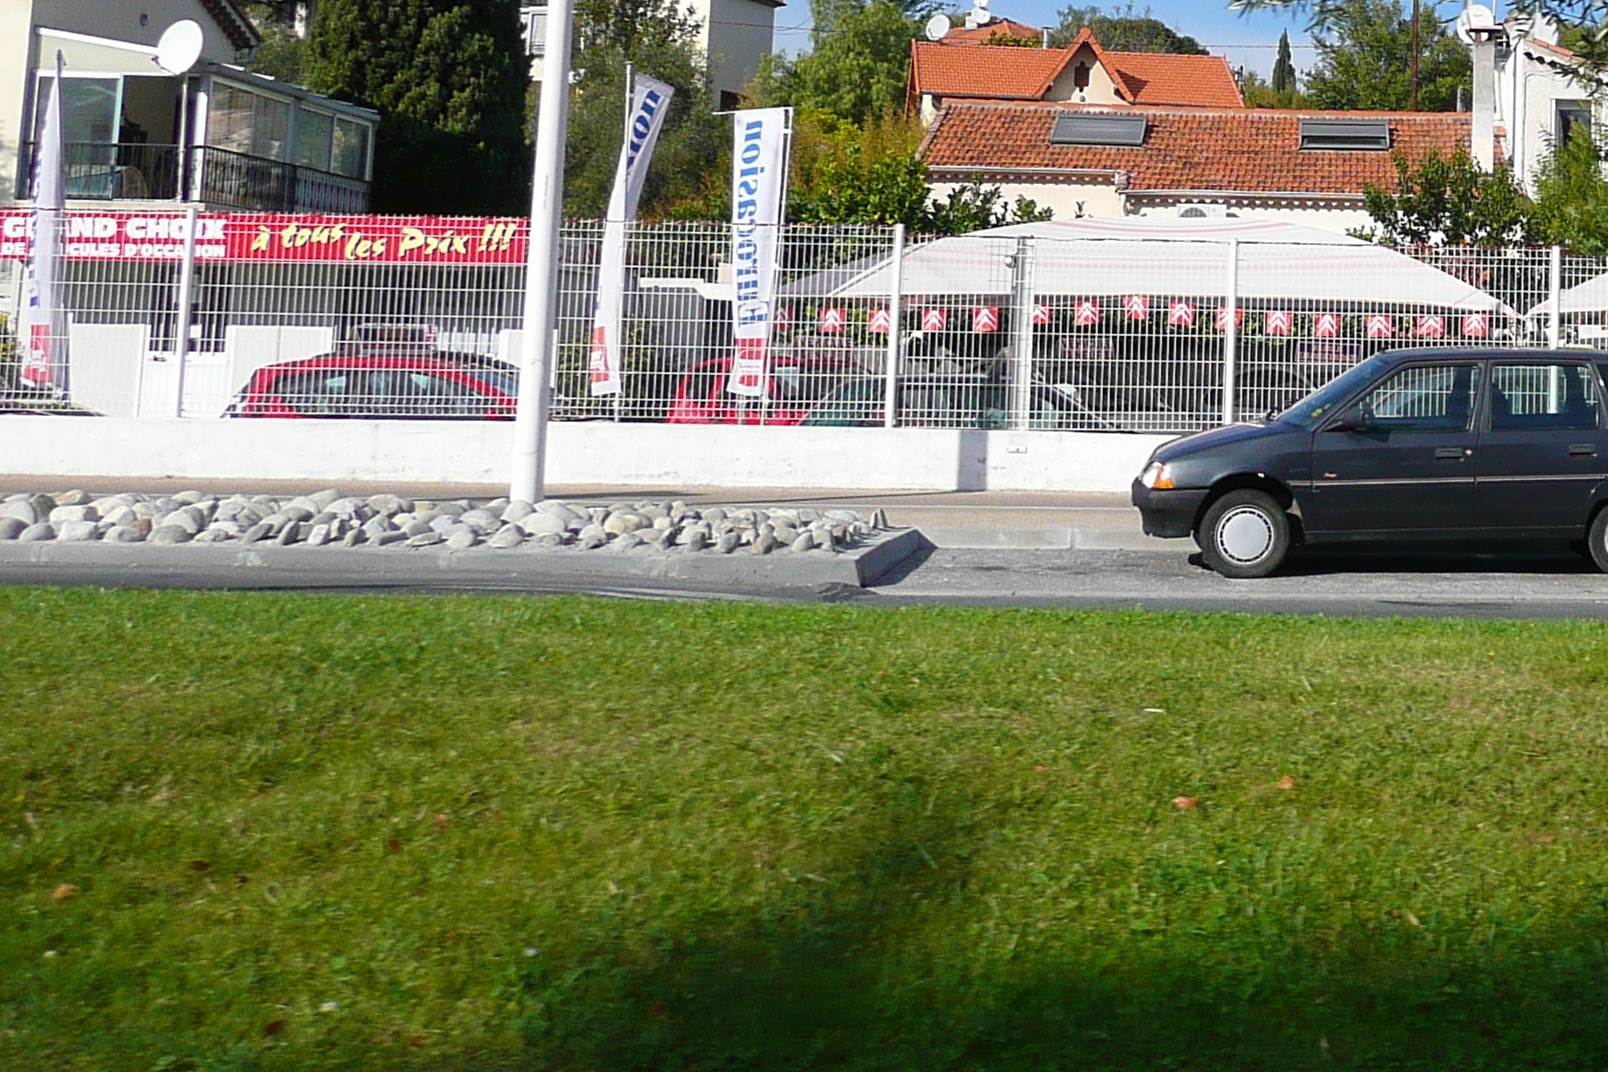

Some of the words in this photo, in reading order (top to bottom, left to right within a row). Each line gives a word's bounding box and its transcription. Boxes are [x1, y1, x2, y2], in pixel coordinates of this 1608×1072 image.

[4, 216, 118, 239] GND
[2, 242, 27, 254] DE
[124, 243, 226, 258] D'OCCAION
[252, 225, 271, 251] à
[282, 221, 347, 249] tous
[346, 231, 388, 260] les
[398, 227, 470, 257] Prix
